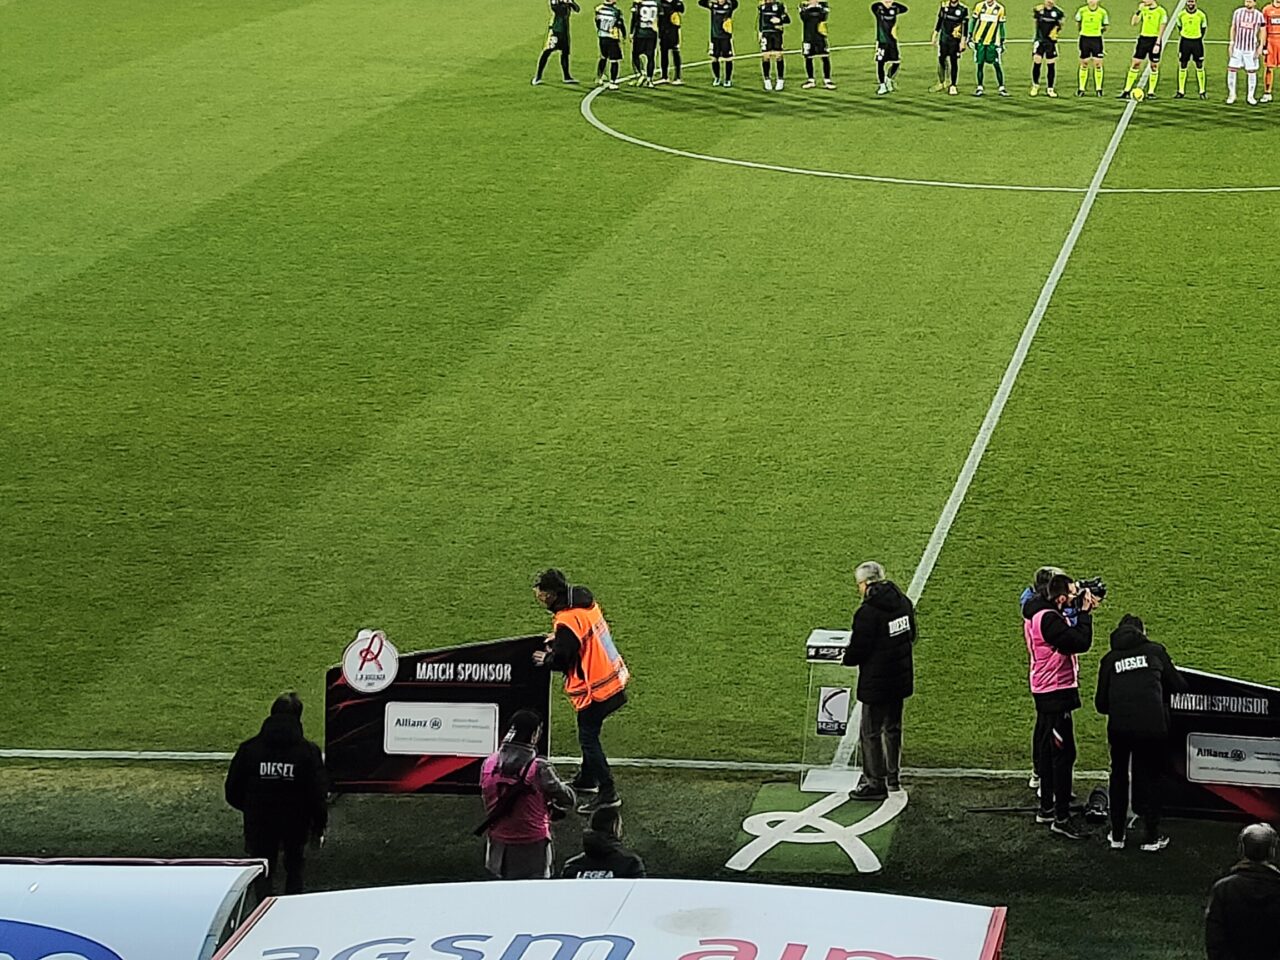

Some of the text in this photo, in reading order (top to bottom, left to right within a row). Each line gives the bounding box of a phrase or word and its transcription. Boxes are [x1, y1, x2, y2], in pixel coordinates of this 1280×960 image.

[416, 662, 512, 682] MATCH SPONSOR
[1114, 655, 1148, 673] DIESEL
[394, 717, 428, 728] Allianz
[260, 762, 295, 778] DIESEL
